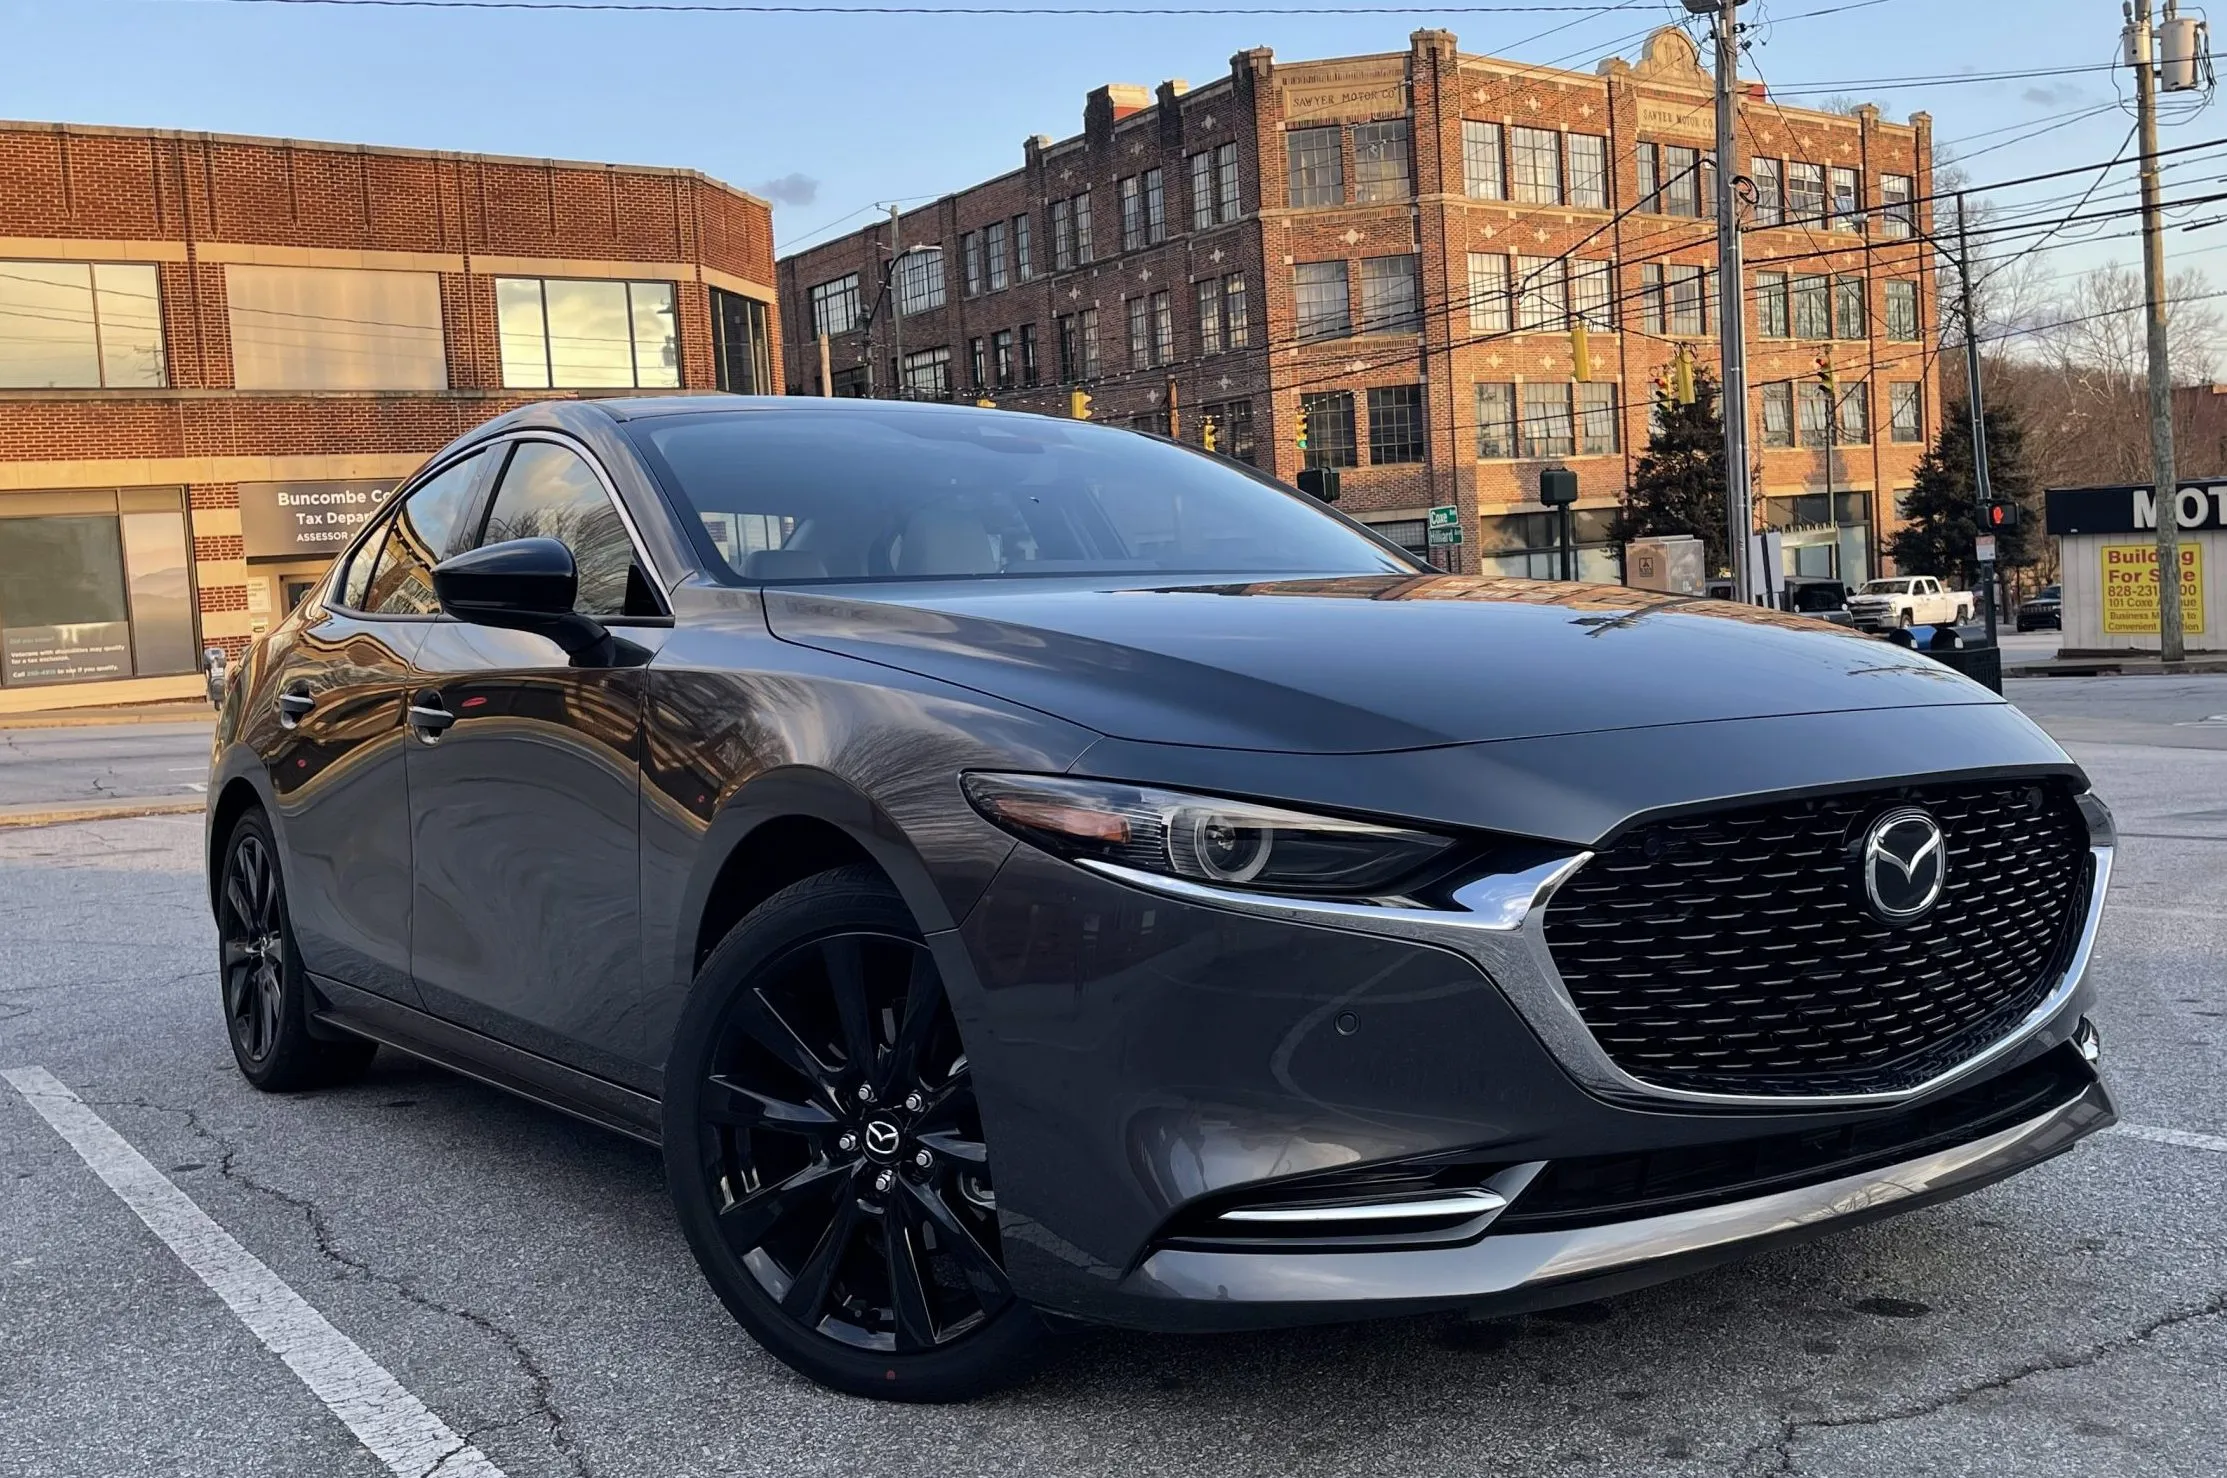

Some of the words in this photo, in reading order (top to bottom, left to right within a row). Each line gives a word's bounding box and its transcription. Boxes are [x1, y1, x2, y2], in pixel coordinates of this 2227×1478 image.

[1293, 95, 1334, 107] SAWYER
[1342, 91, 1377, 104] MOTOR
[1643, 109, 1673, 123] SAWYER
[1676, 114, 1700, 128] MOTOR
[277, 490, 366, 506] Buncombe
[296, 513, 322, 525] Tax
[1431, 511, 1447, 525] Coxe
[296, 532, 348, 542] ASSESSOR
[2108, 549, 2194, 566] Buildg
[2109, 570, 2142, 583] For
[2149, 568, 2195, 583] Se
[2108, 585, 2197, 597] 828-23100
[2110, 598, 2124, 607] 101
[2127, 598, 2153, 607] Coxe
[2110, 612, 2149, 620] Business
[2187, 611, 2196, 620] to
[2108, 623, 2157, 631] Convenient
